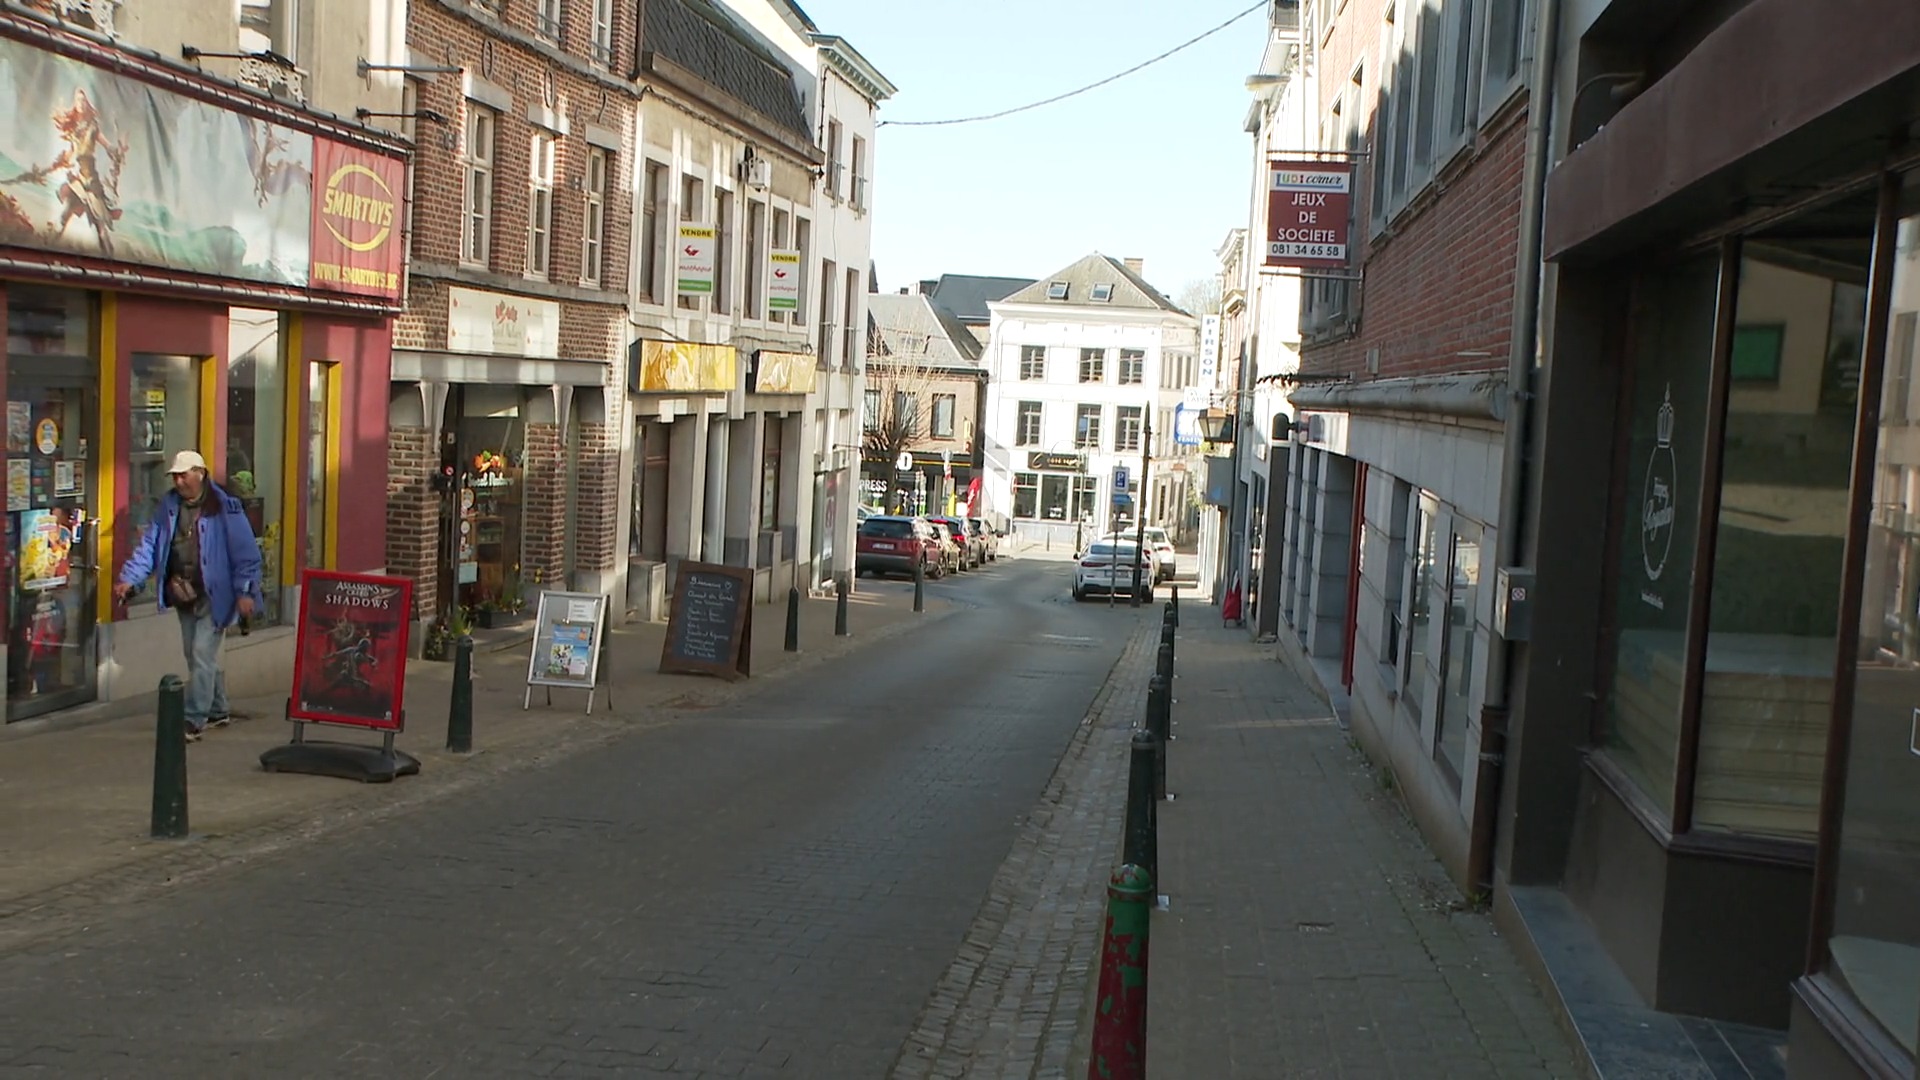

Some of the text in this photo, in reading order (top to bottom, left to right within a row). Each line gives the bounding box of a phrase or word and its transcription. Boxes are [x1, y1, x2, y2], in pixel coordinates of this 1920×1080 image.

[1291, 193, 1326, 206] JEUX
[323, 188, 393, 226] SMARTOYS
[1298, 211, 1317, 224] DE
[681, 228, 712, 237] VENDRE
[1277, 228, 1336, 242] SOCIETE
[1271, 244, 1339, 256] 081 34 65 58
[771, 254, 798, 262] VENDRE
[1202, 318, 1216, 376] PIRSON
[325, 593, 389, 610] SHADOWS
